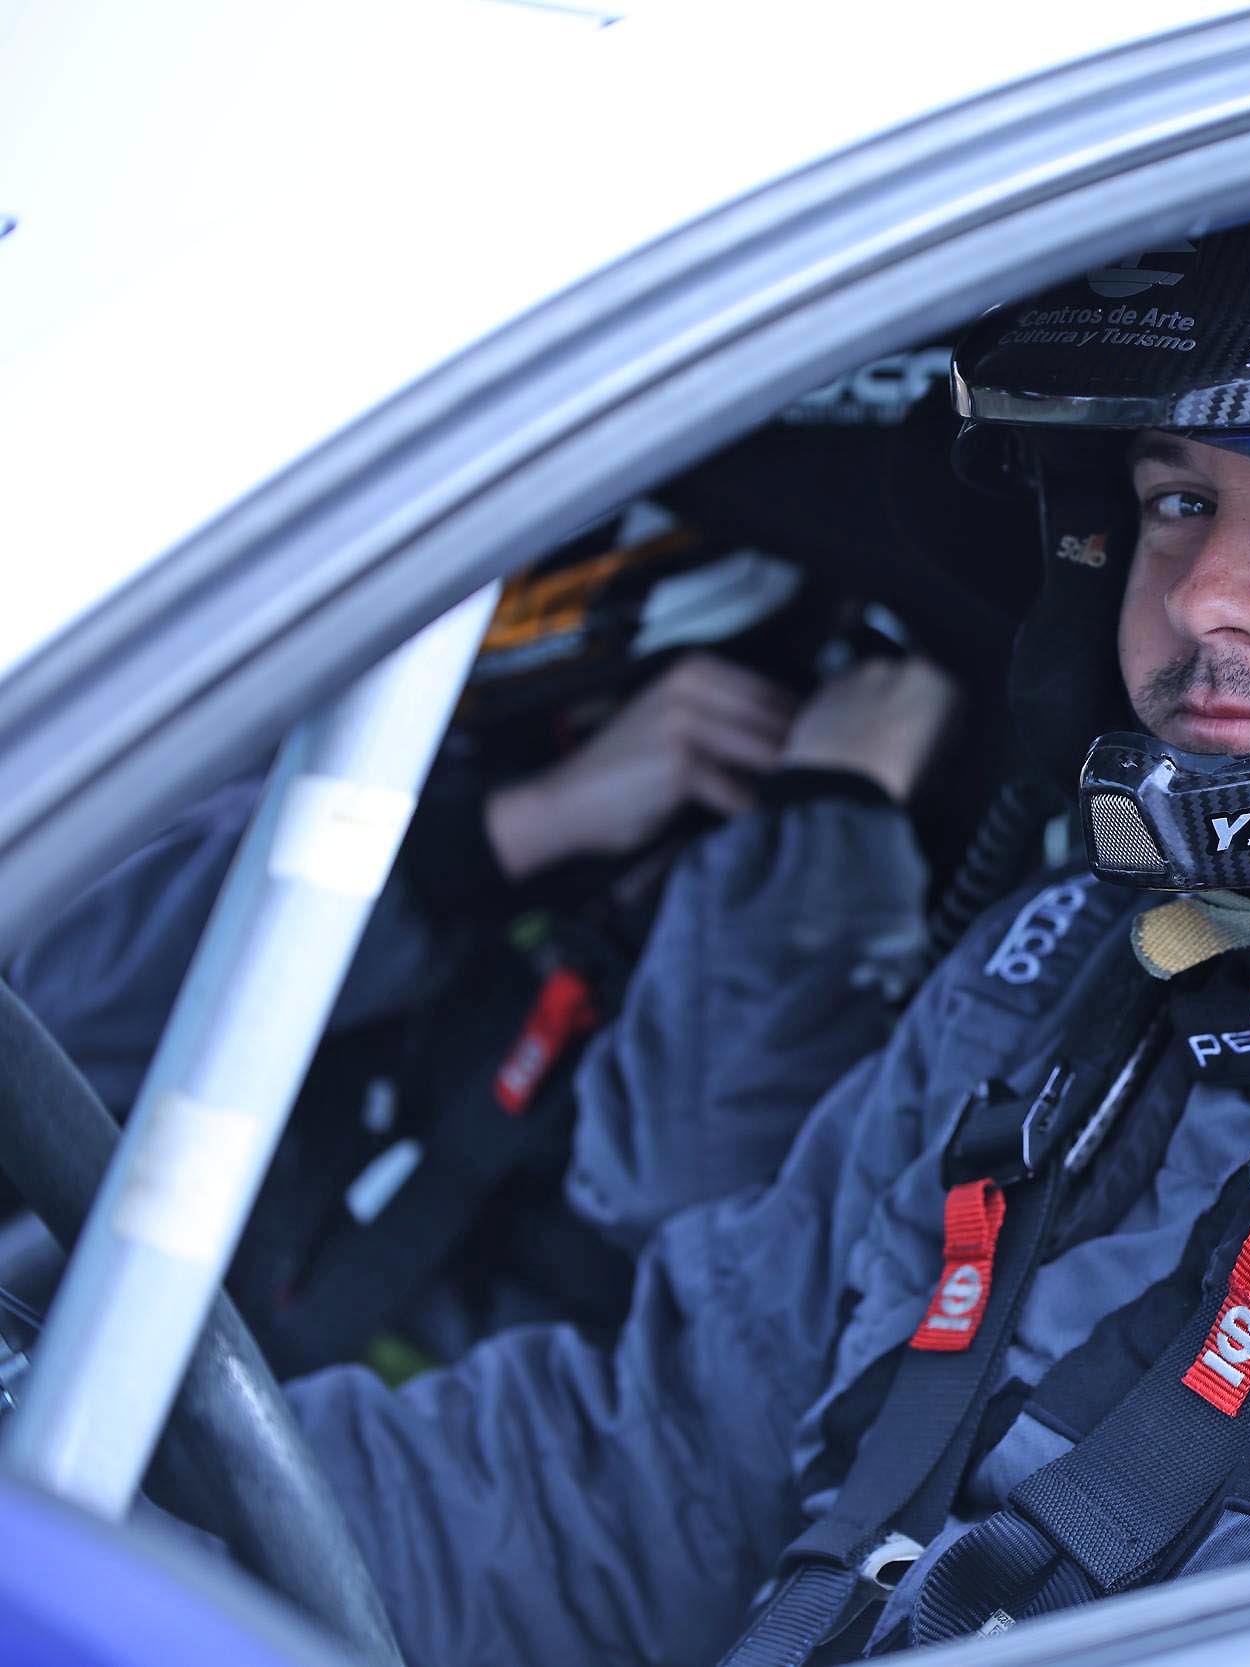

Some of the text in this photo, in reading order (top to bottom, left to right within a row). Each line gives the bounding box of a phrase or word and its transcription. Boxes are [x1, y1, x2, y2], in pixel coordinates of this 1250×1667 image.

[1019, 304, 1196, 332] Centros de Arte
[1101, 327, 1197, 352] Turismo
